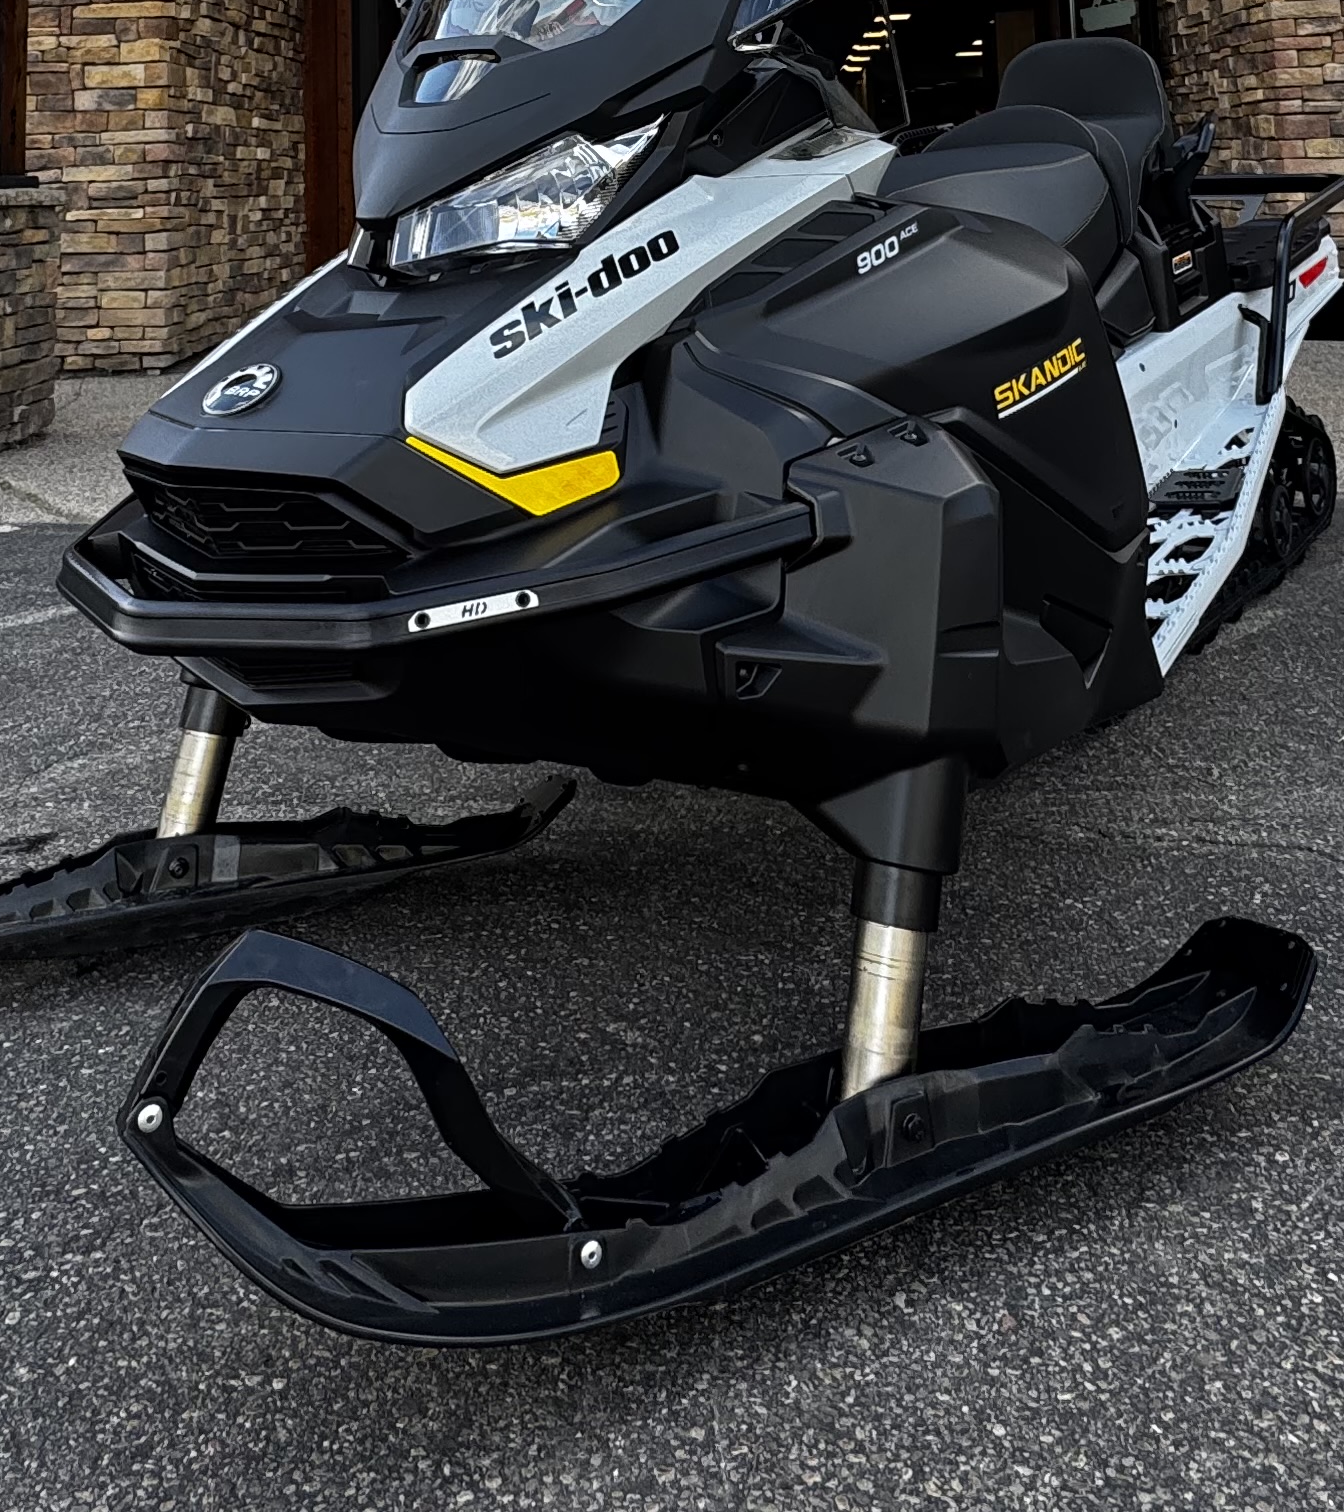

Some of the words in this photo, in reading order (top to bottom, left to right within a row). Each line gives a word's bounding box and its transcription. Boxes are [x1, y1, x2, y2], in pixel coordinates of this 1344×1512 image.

[856, 235, 900, 275] 900
[899, 220, 919, 241] ACE
[489, 229, 680, 360] ski-doo
[223, 385, 261, 398] BRP
[994, 337, 1086, 411] SKANDIC
[461, 601, 488, 619] HD
